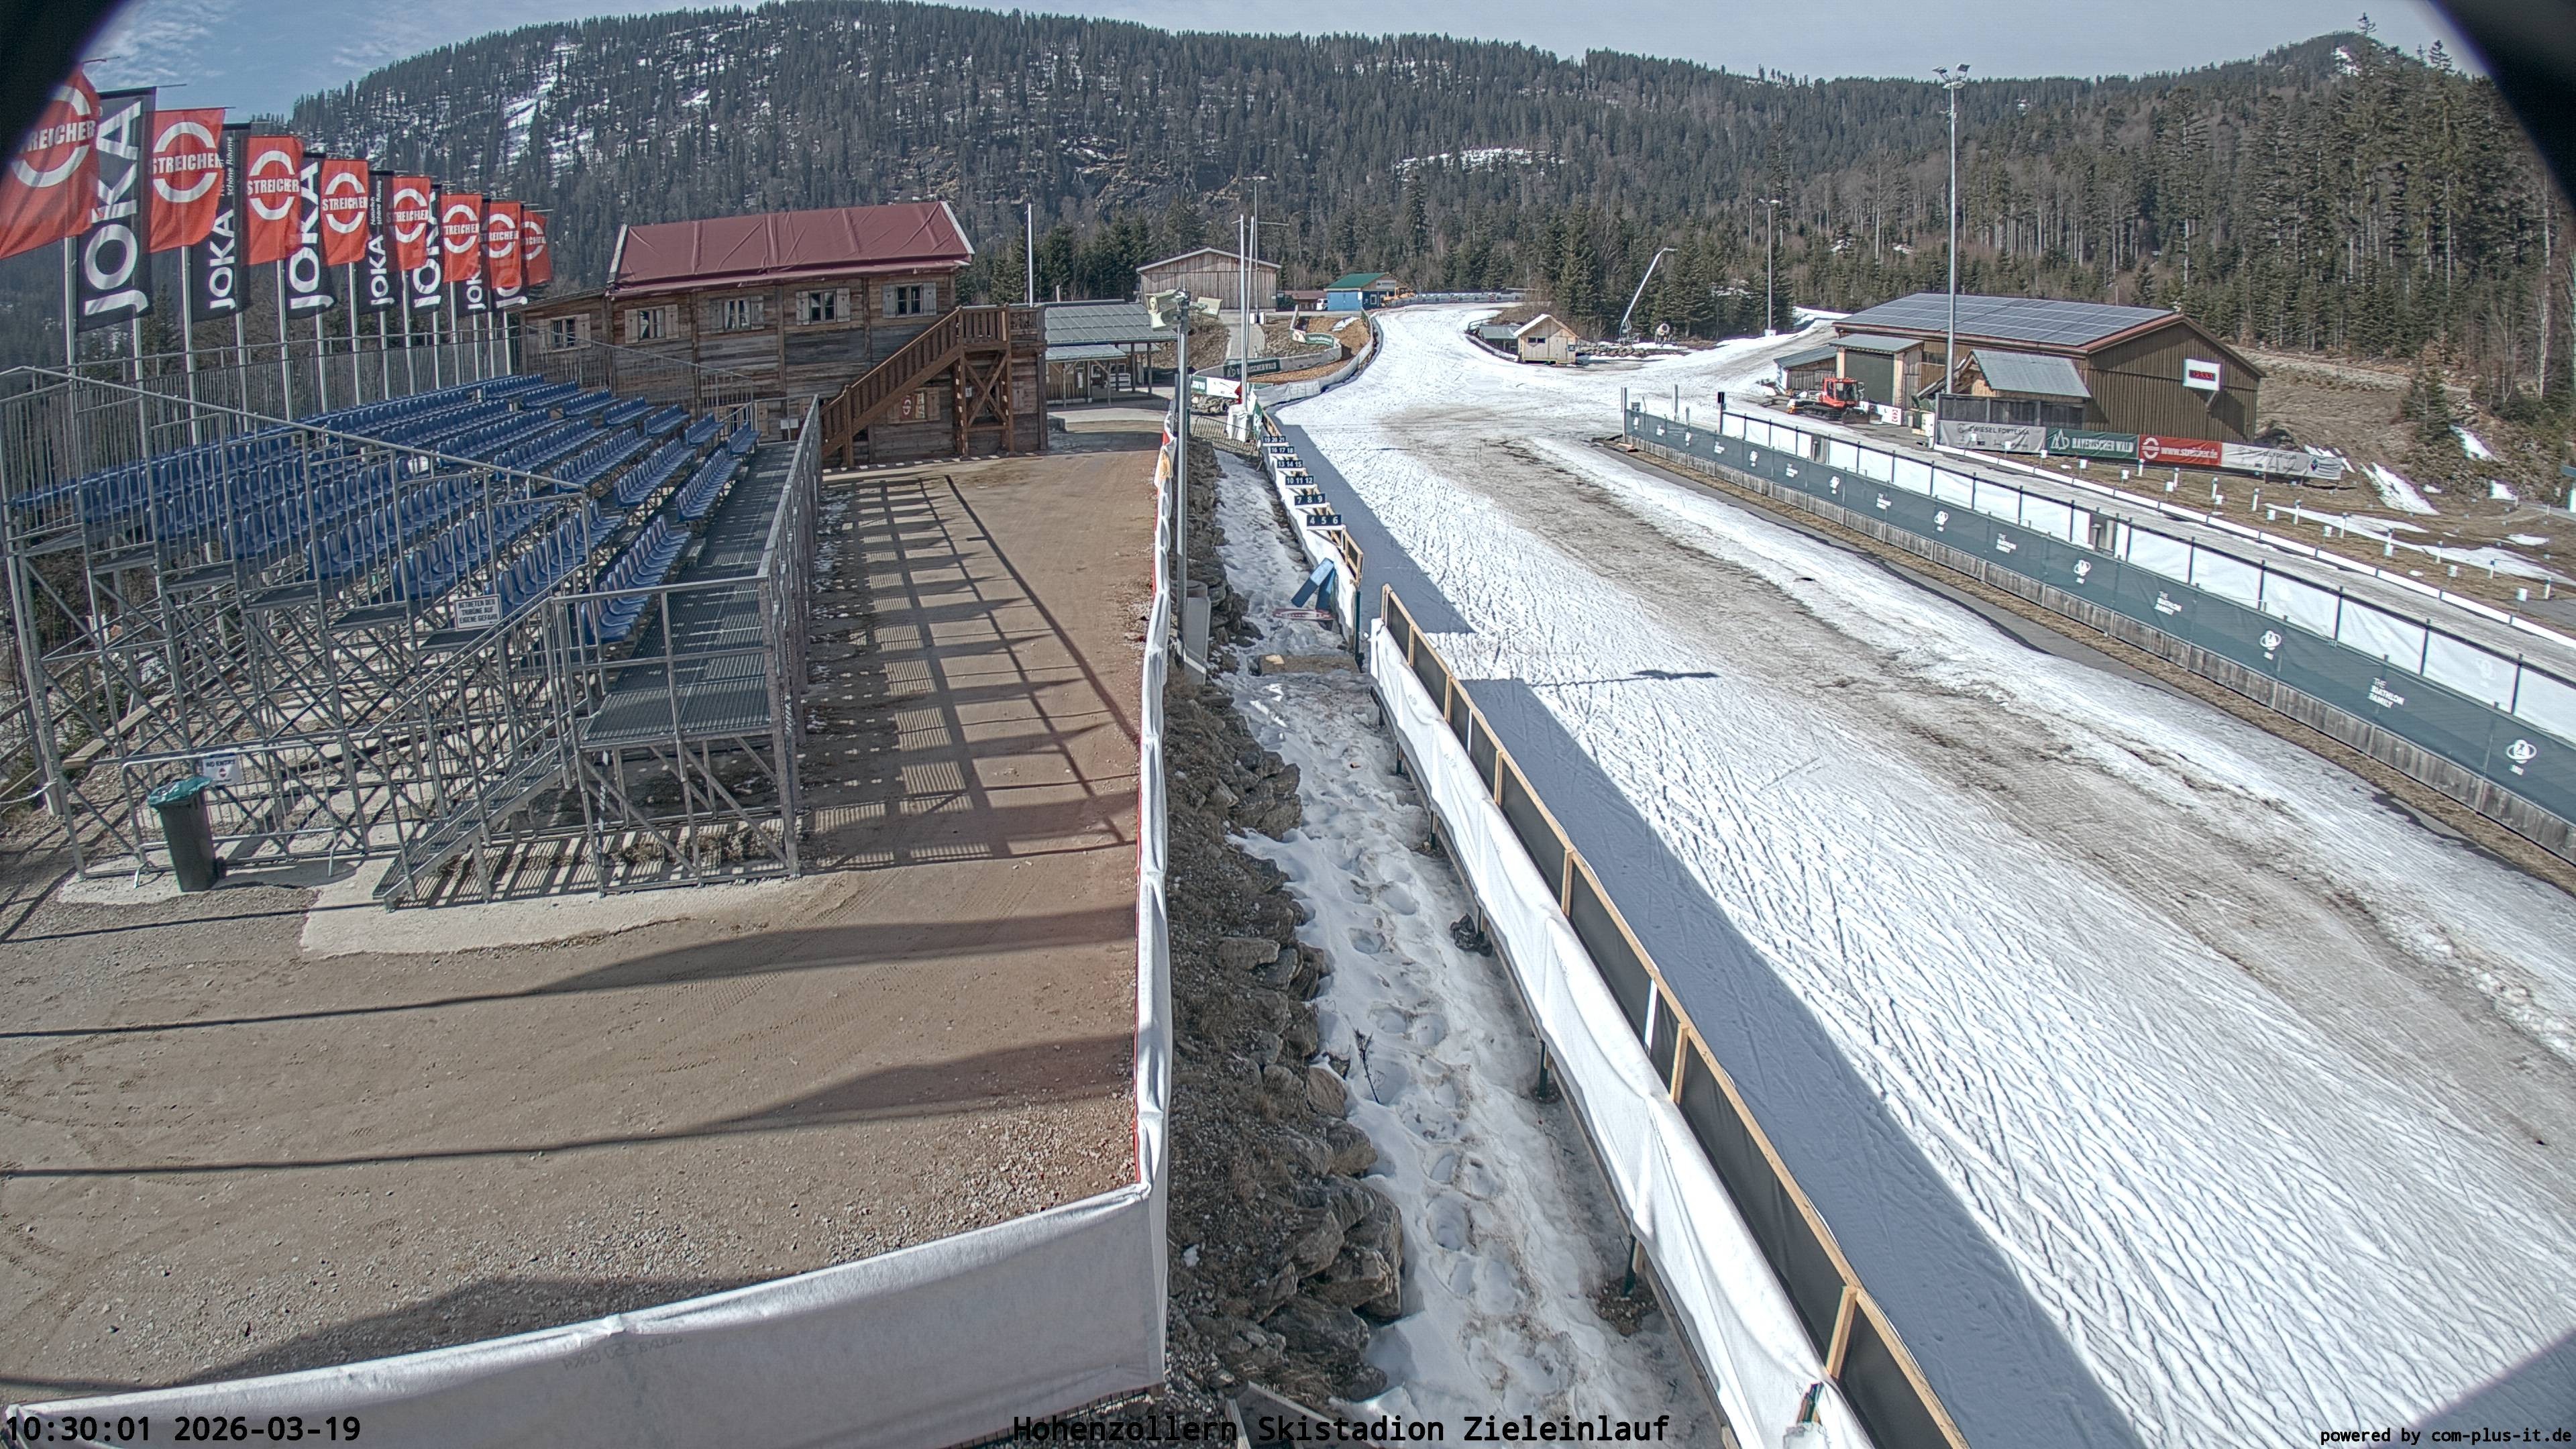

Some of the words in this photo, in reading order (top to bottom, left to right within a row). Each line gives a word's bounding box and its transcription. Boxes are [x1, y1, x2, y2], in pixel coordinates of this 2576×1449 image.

[85, 101, 149, 315] JOKA
[247, 178, 300, 196] STREICHER
[209, 209, 236, 309] JOKA
[290, 162, 334, 309] JOKA
[368, 235, 394, 305] JOKA
[2116, 441, 2133, 453] WALD
